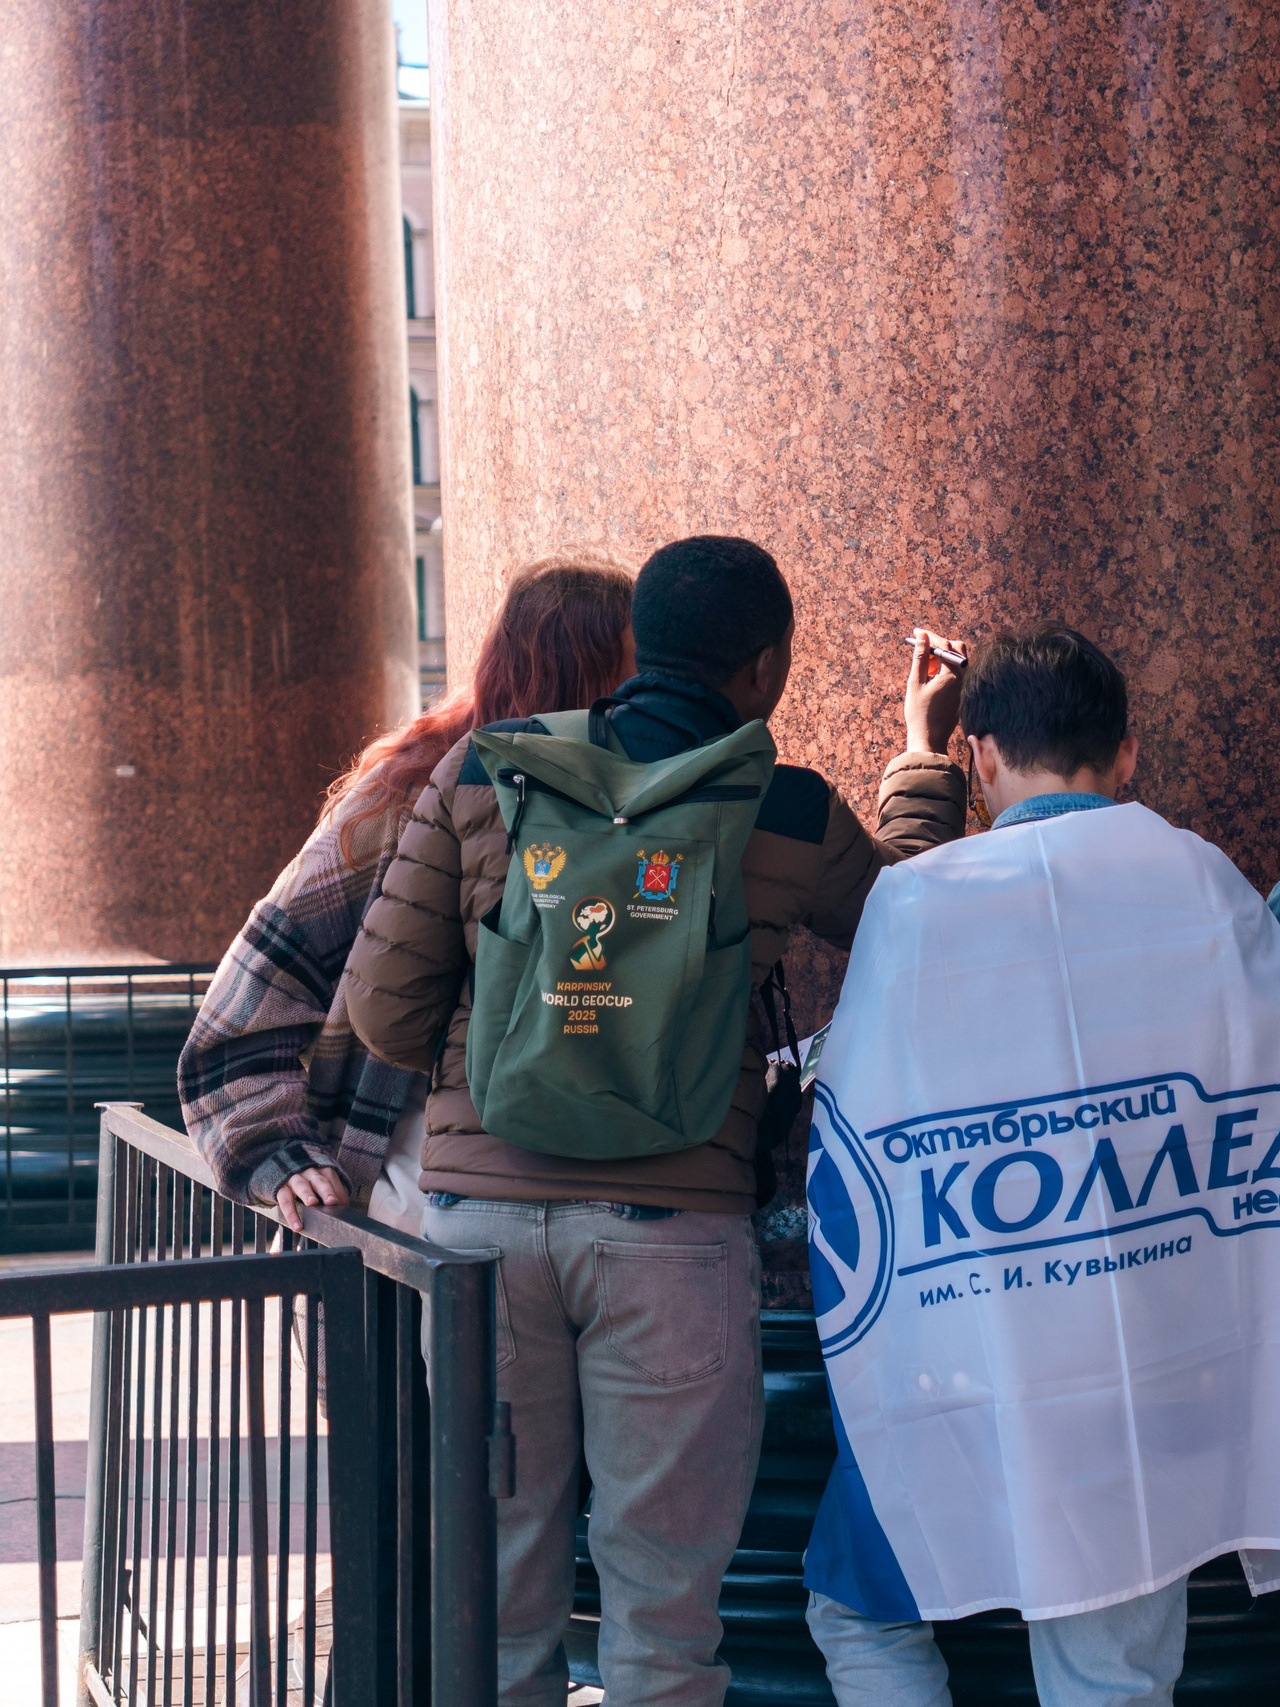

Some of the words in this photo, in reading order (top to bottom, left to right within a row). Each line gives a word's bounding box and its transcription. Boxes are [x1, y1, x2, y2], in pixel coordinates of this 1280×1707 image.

[630, 911, 674, 921] GOVERNMENT
[636, 905, 679, 916] PETERSBURG
[556, 981, 612, 992] KARPINSKY
[581, 994, 633, 1008] GEOCUP
[567, 1009, 597, 1021] 2025
[563, 1024, 599, 1034] RUSSIA
[882, 1084, 1177, 1163] Октябрьский
[919, 1283, 964, 1308] им.
[968, 1272, 991, 1295] С.
[1003, 1266, 1033, 1290] И.
[1044, 1235, 1193, 1286] Кувыкина
